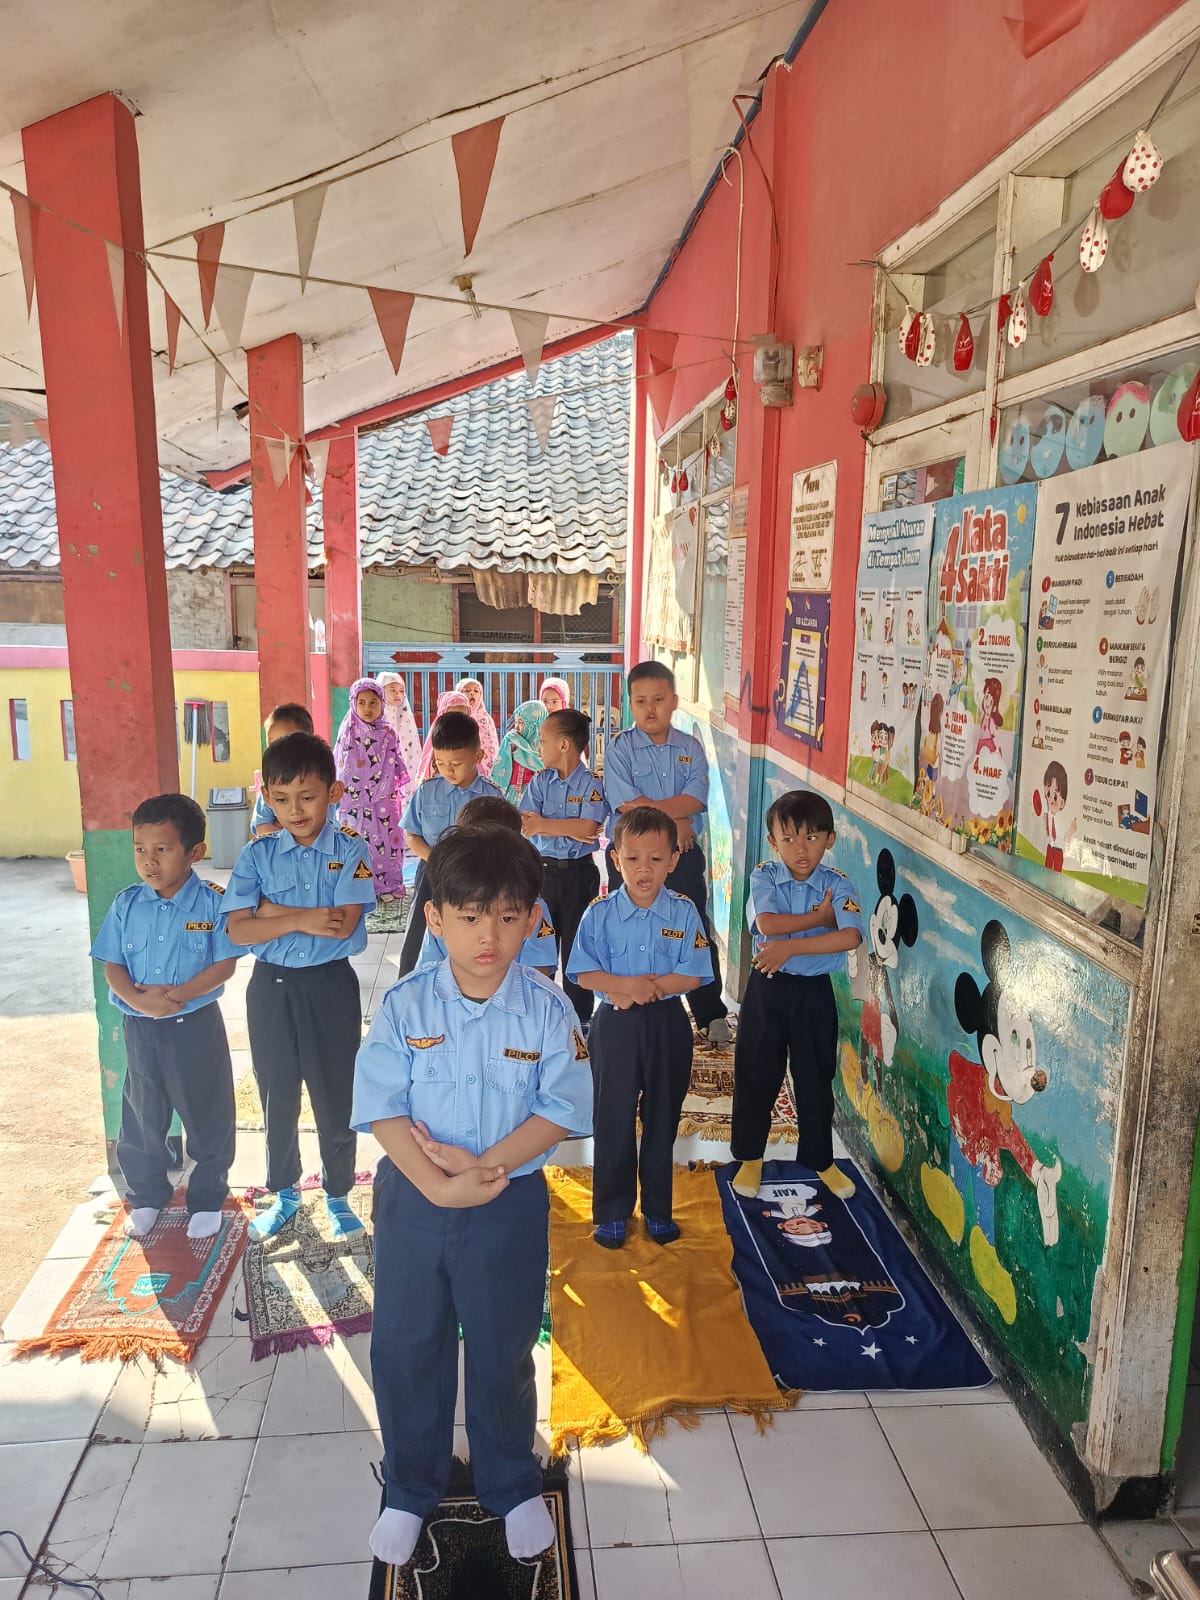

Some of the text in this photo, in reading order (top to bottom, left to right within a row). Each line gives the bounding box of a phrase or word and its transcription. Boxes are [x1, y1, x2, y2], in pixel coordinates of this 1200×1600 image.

[1076, 484, 1166, 518] Kebiasaan Anak
[961, 508, 1007, 555] Kata
[1055, 502, 1070, 545] 7
[1074, 510, 1164, 541] Indonesia Hebat
[1125, 544, 1143, 556] setiap
[1143, 540, 1159, 551] hari
[941, 526, 960, 603] 4
[955, 554, 1009, 603] Sakti
[978, 628, 1011, 646] 2. TOLONG
[973, 756, 1003, 779] 4. MAAF
[1108, 777, 1129, 788] CEPAT
[508, 1050, 539, 1061] PILOT
